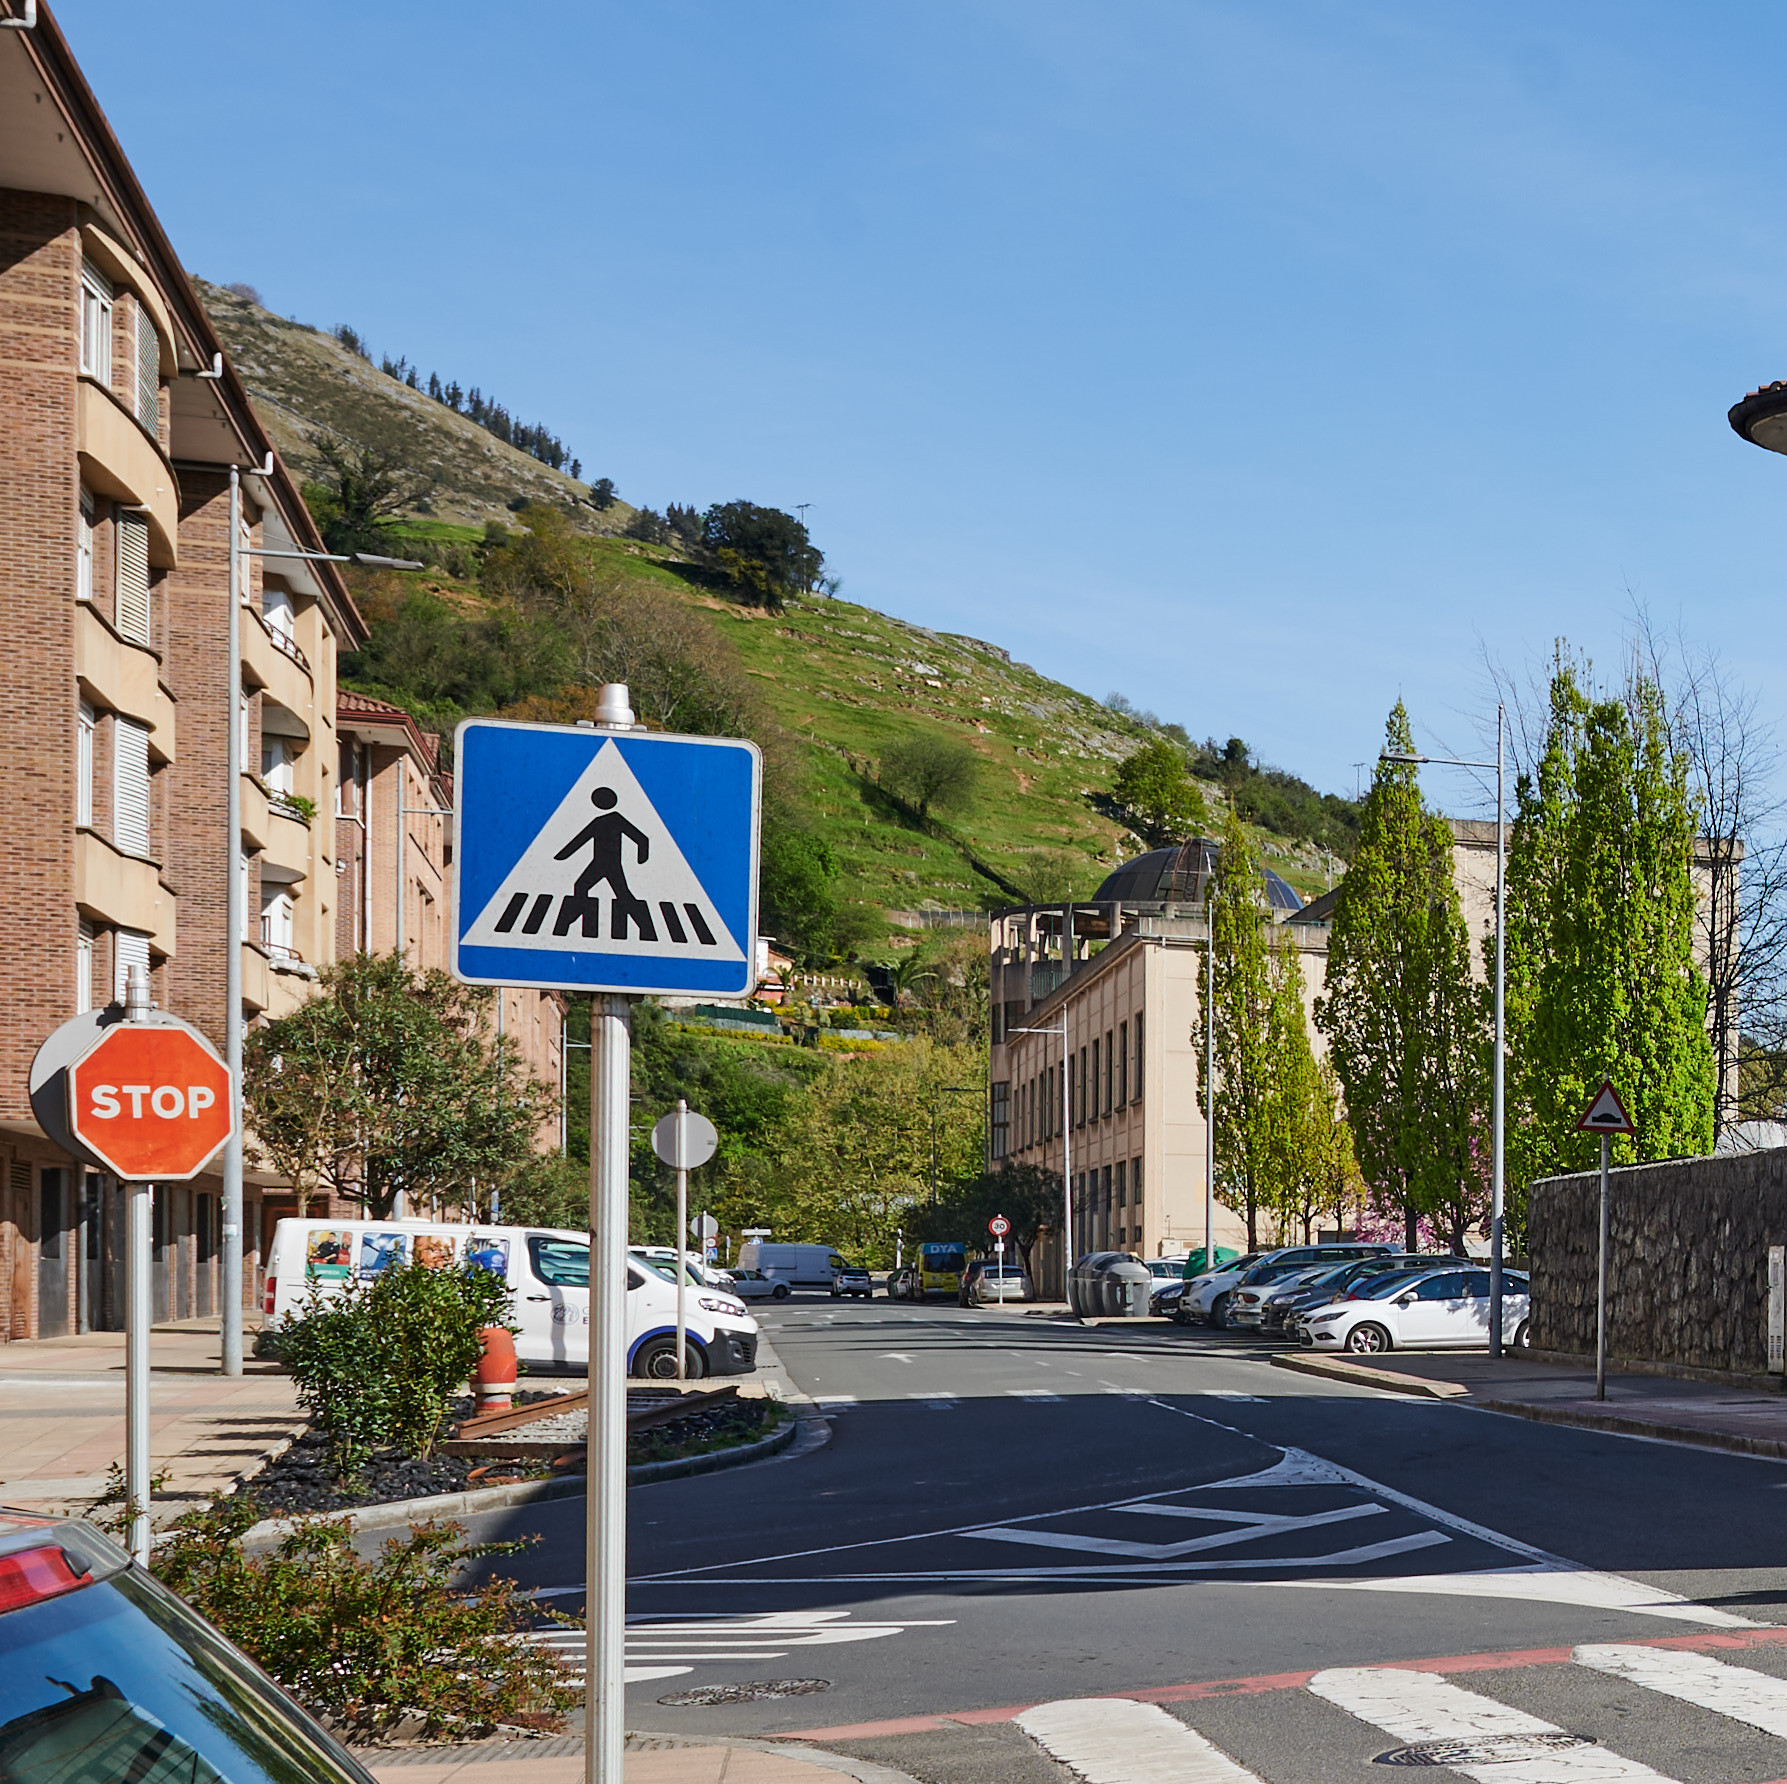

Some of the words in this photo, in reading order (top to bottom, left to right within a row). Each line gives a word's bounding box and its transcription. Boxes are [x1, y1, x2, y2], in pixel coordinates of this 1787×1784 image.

[90, 1084, 216, 1120] STOP
[994, 1222, 1006, 1230] 30
[930, 1244, 958, 1254] DYA
